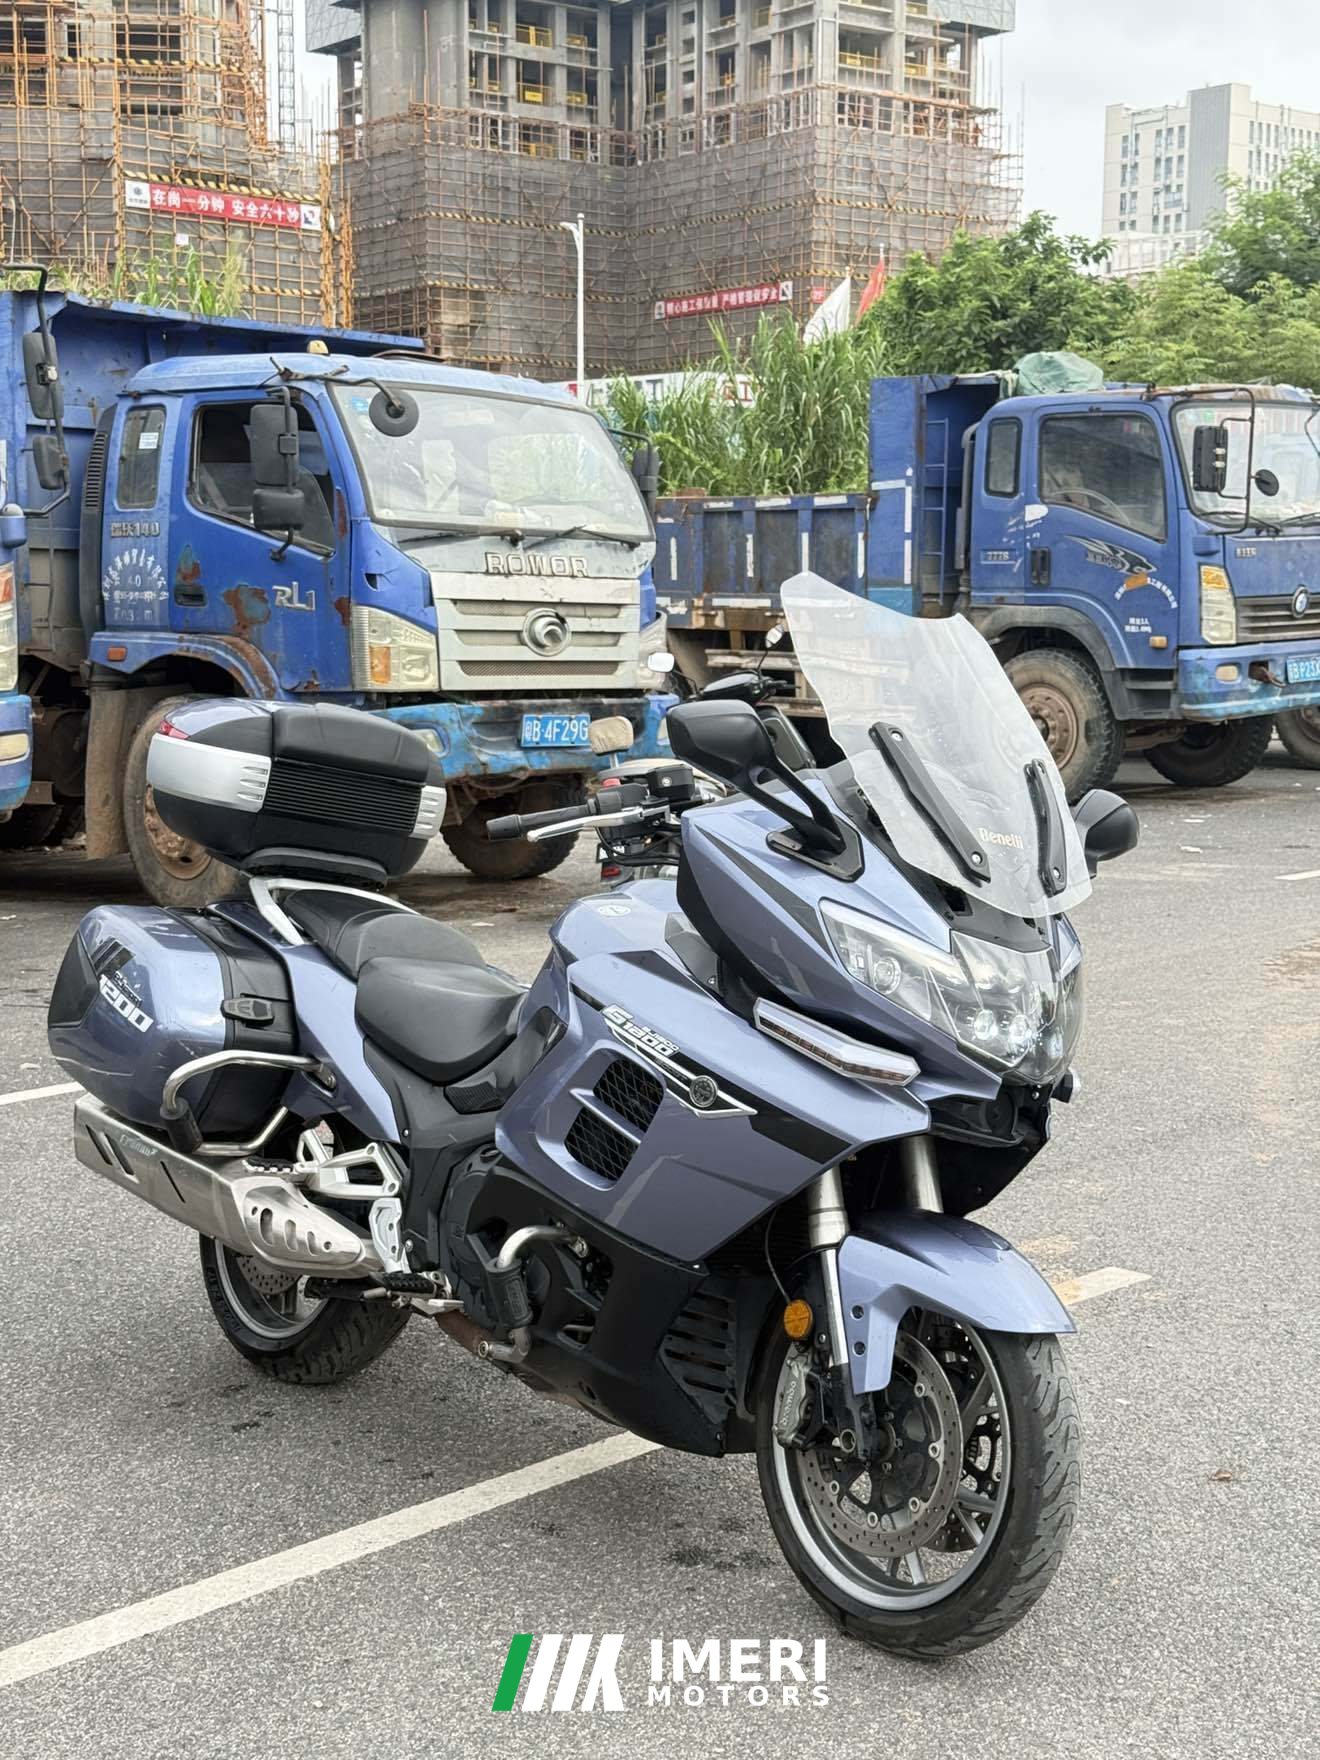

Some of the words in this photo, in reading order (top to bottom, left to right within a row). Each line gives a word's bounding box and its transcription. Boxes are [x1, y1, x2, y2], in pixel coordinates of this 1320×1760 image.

[151, 188, 225, 213] 在岗一分钟
[231, 199, 300, 223] 安全六十秒
[485, 552, 589, 577] ROWOR
[979, 828, 1024, 849] Benelli
